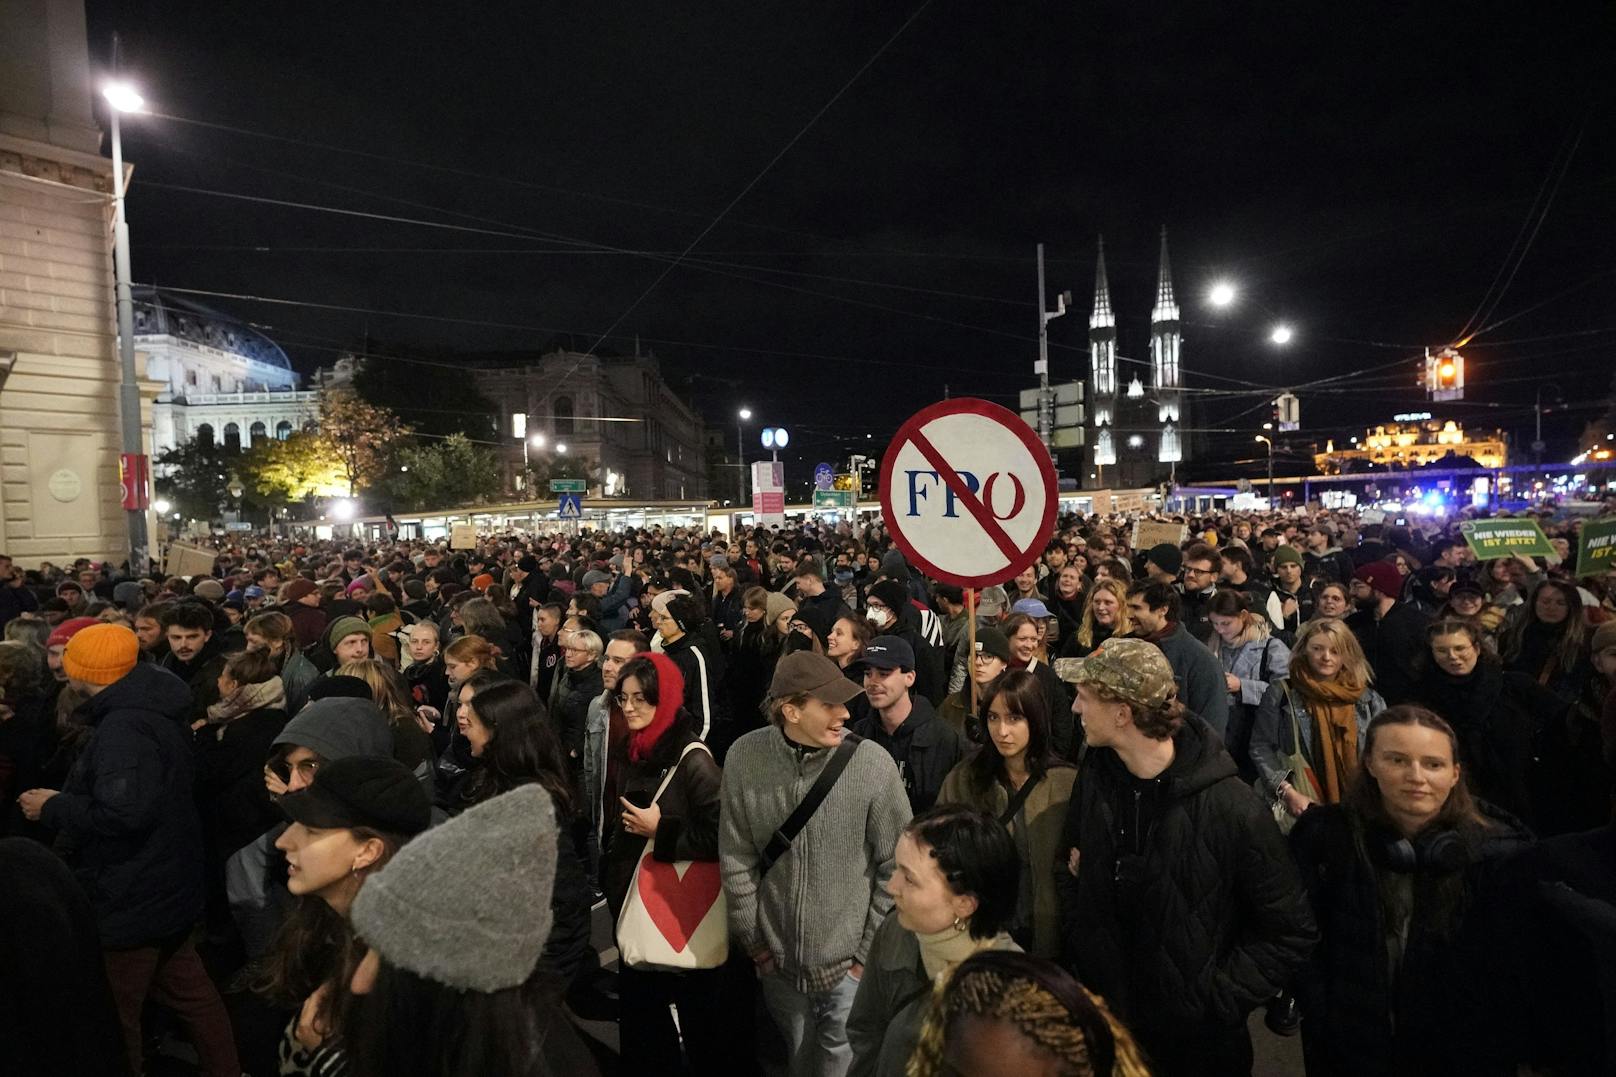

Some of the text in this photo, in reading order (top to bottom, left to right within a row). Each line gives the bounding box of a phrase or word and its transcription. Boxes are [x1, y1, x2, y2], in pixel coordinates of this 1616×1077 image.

[1473, 529, 1536, 540] NIE WIEDER
[1483, 539, 1501, 547] IST
[1587, 535, 1610, 549] NIE
[1591, 546, 1613, 559] IST
